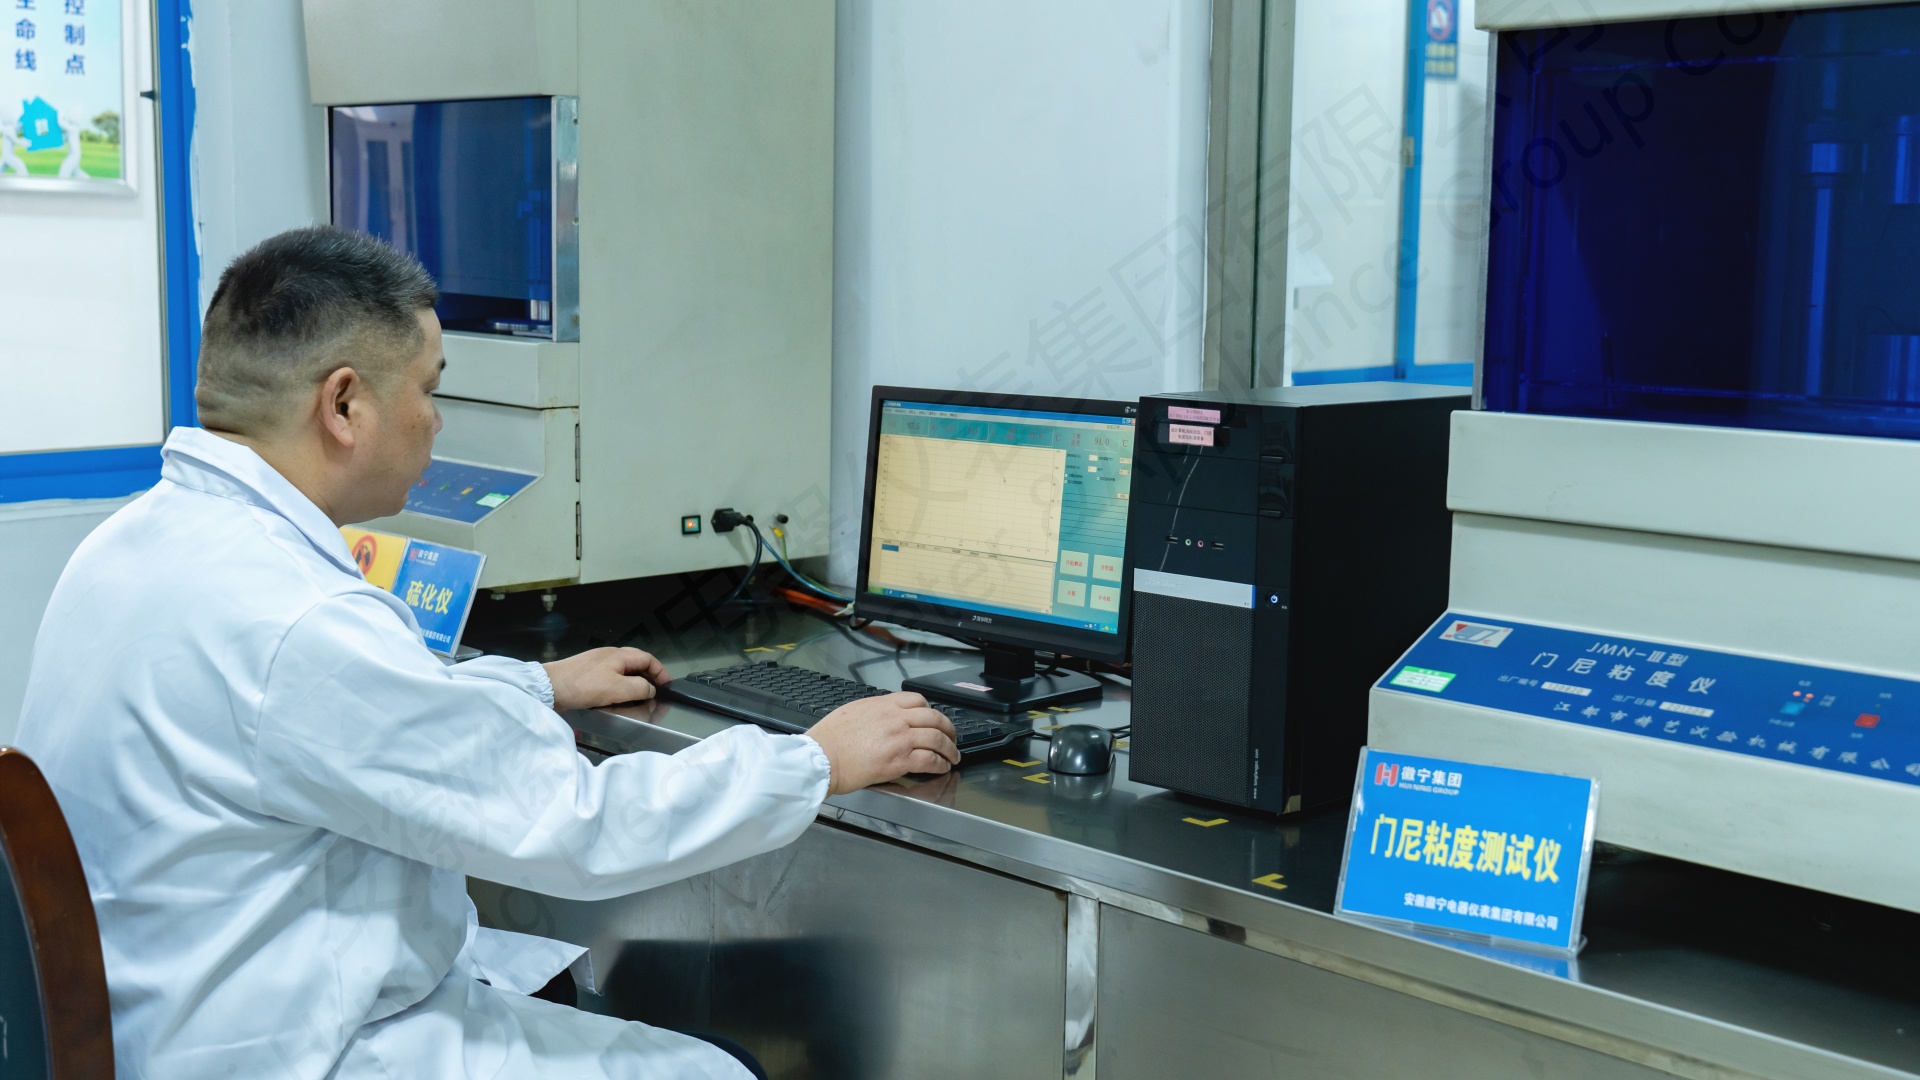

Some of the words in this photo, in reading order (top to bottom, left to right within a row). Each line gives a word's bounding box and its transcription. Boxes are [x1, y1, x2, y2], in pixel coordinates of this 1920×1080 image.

[64, 0, 85, 76] 控制点
[405, 580, 453, 615] 硫化仪
[1530, 652, 1716, 695] 门尼粘度仪
[1400, 765, 1463, 789] 徽宁集团
[1432, 786, 1460, 796] GROUP
[1370, 813, 1562, 884] 门尼粘度测试仪
[1403, 891, 1559, 932] 安徽徽宁电器仪表集团有限公司
